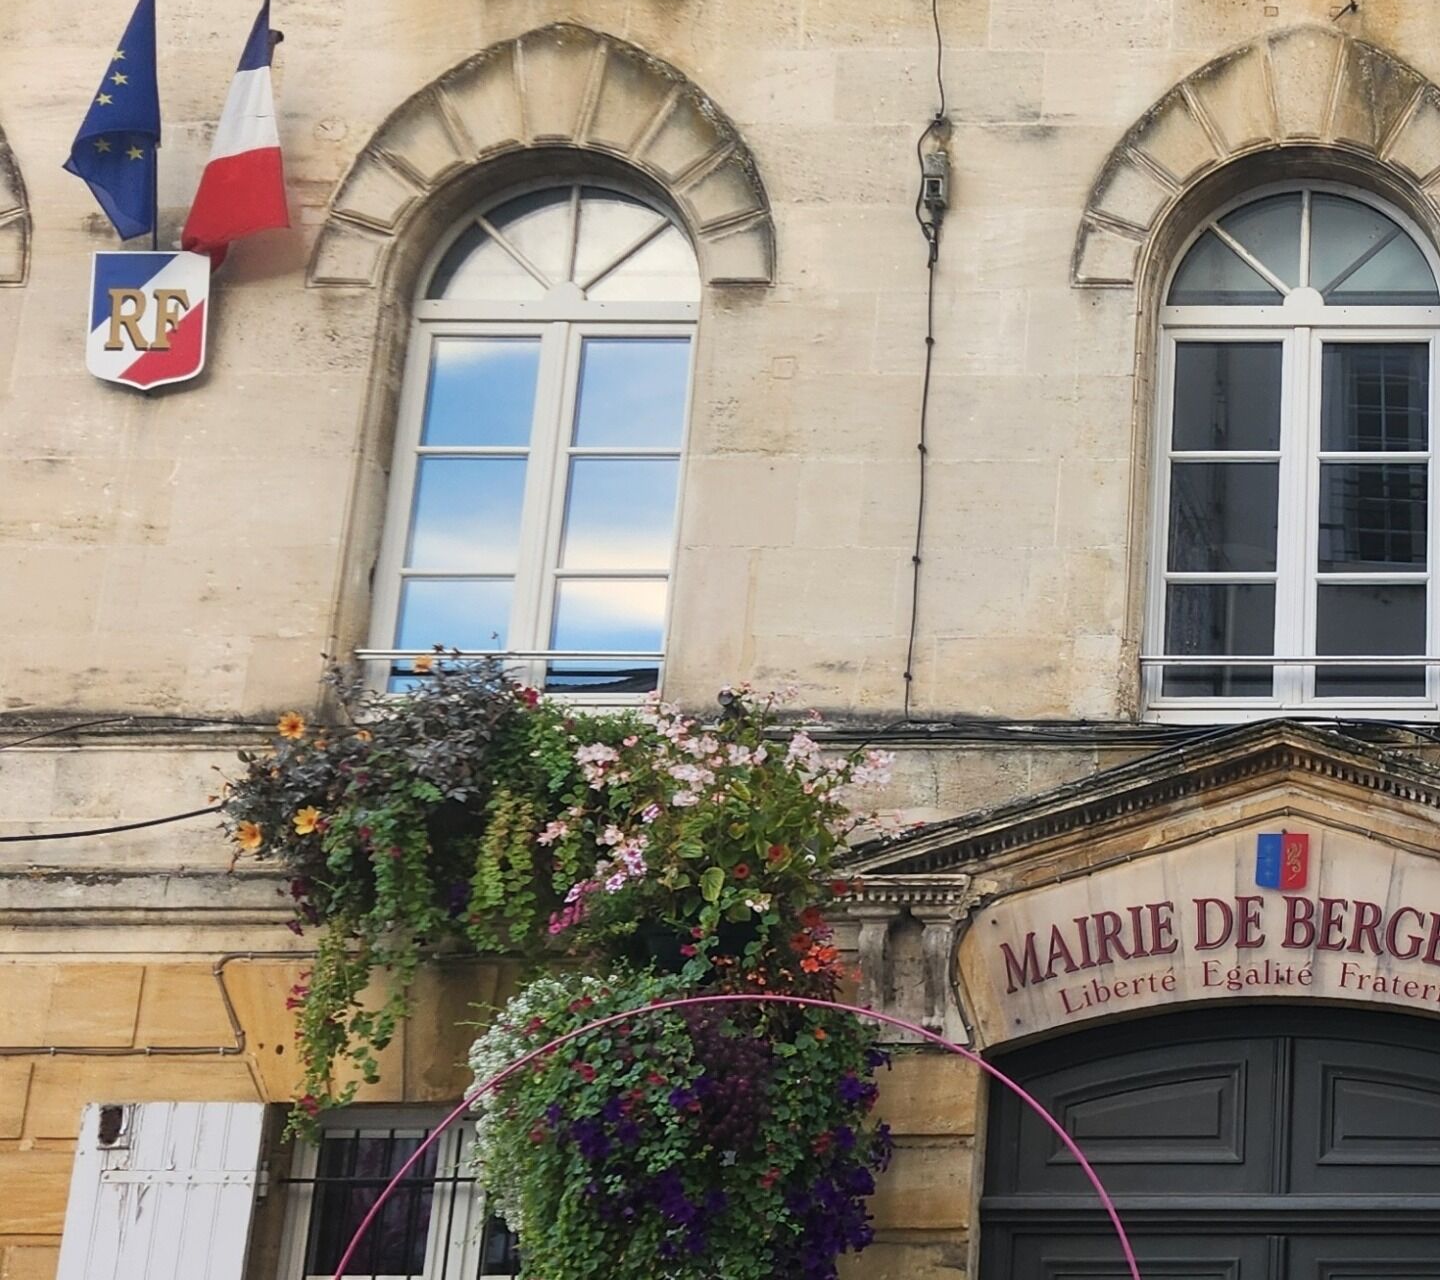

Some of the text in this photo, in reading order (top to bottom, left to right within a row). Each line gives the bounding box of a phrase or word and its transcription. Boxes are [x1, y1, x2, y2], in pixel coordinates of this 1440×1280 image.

[103, 288, 191, 352] RF
[1000, 901, 1179, 994] MAIRIE
[1192, 895, 1267, 952] DE
[1058, 966, 1178, 1015] Liberté
[1202, 959, 1313, 992] Egalité
